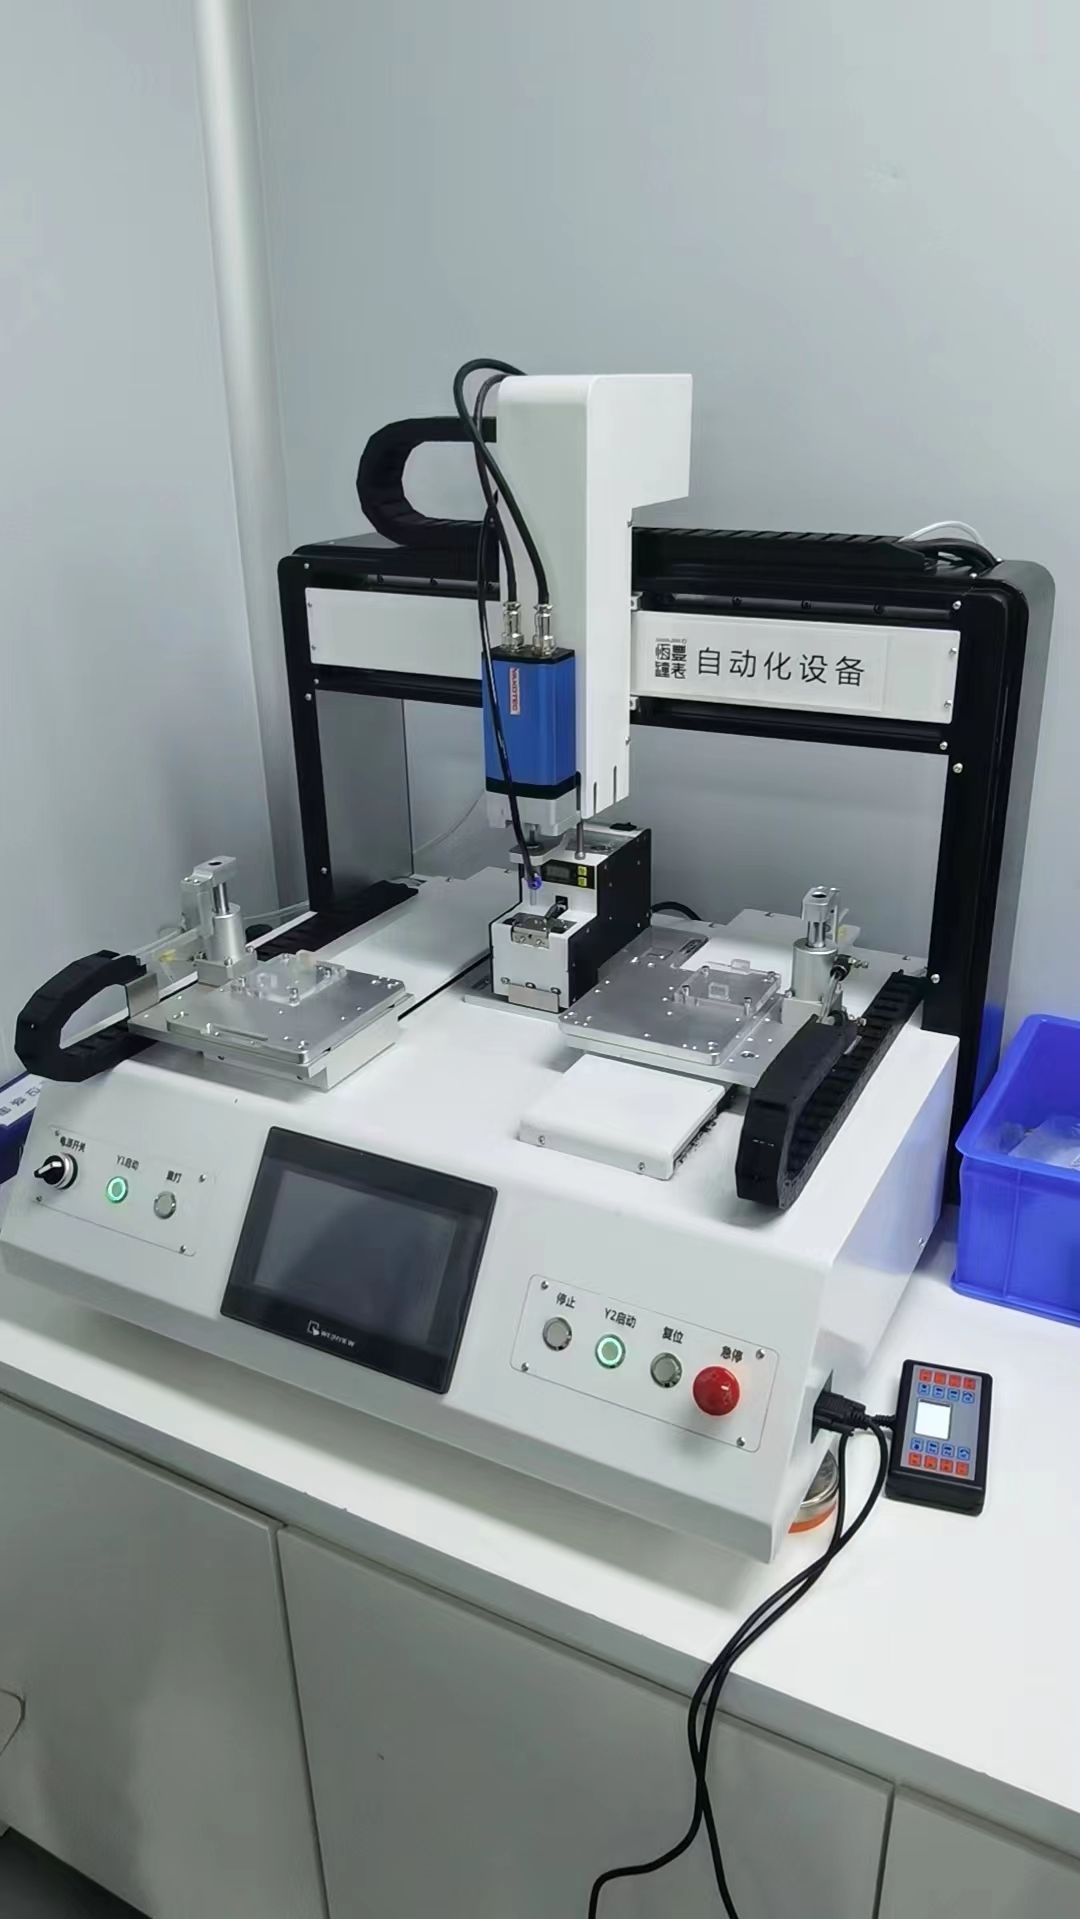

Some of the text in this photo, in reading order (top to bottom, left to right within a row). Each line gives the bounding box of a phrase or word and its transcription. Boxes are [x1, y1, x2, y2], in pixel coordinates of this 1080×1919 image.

[698, 647, 865, 687] 自动化设备
[60, 1135, 87, 1153] 电源开关
[116, 1154, 140, 1171] Y1启动
[556, 1292, 576, 1309] 停止
[604, 1307, 637, 1329] Y2启动
[662, 1326, 684, 1344] 复位
[720, 1345, 744, 1364] 急停
